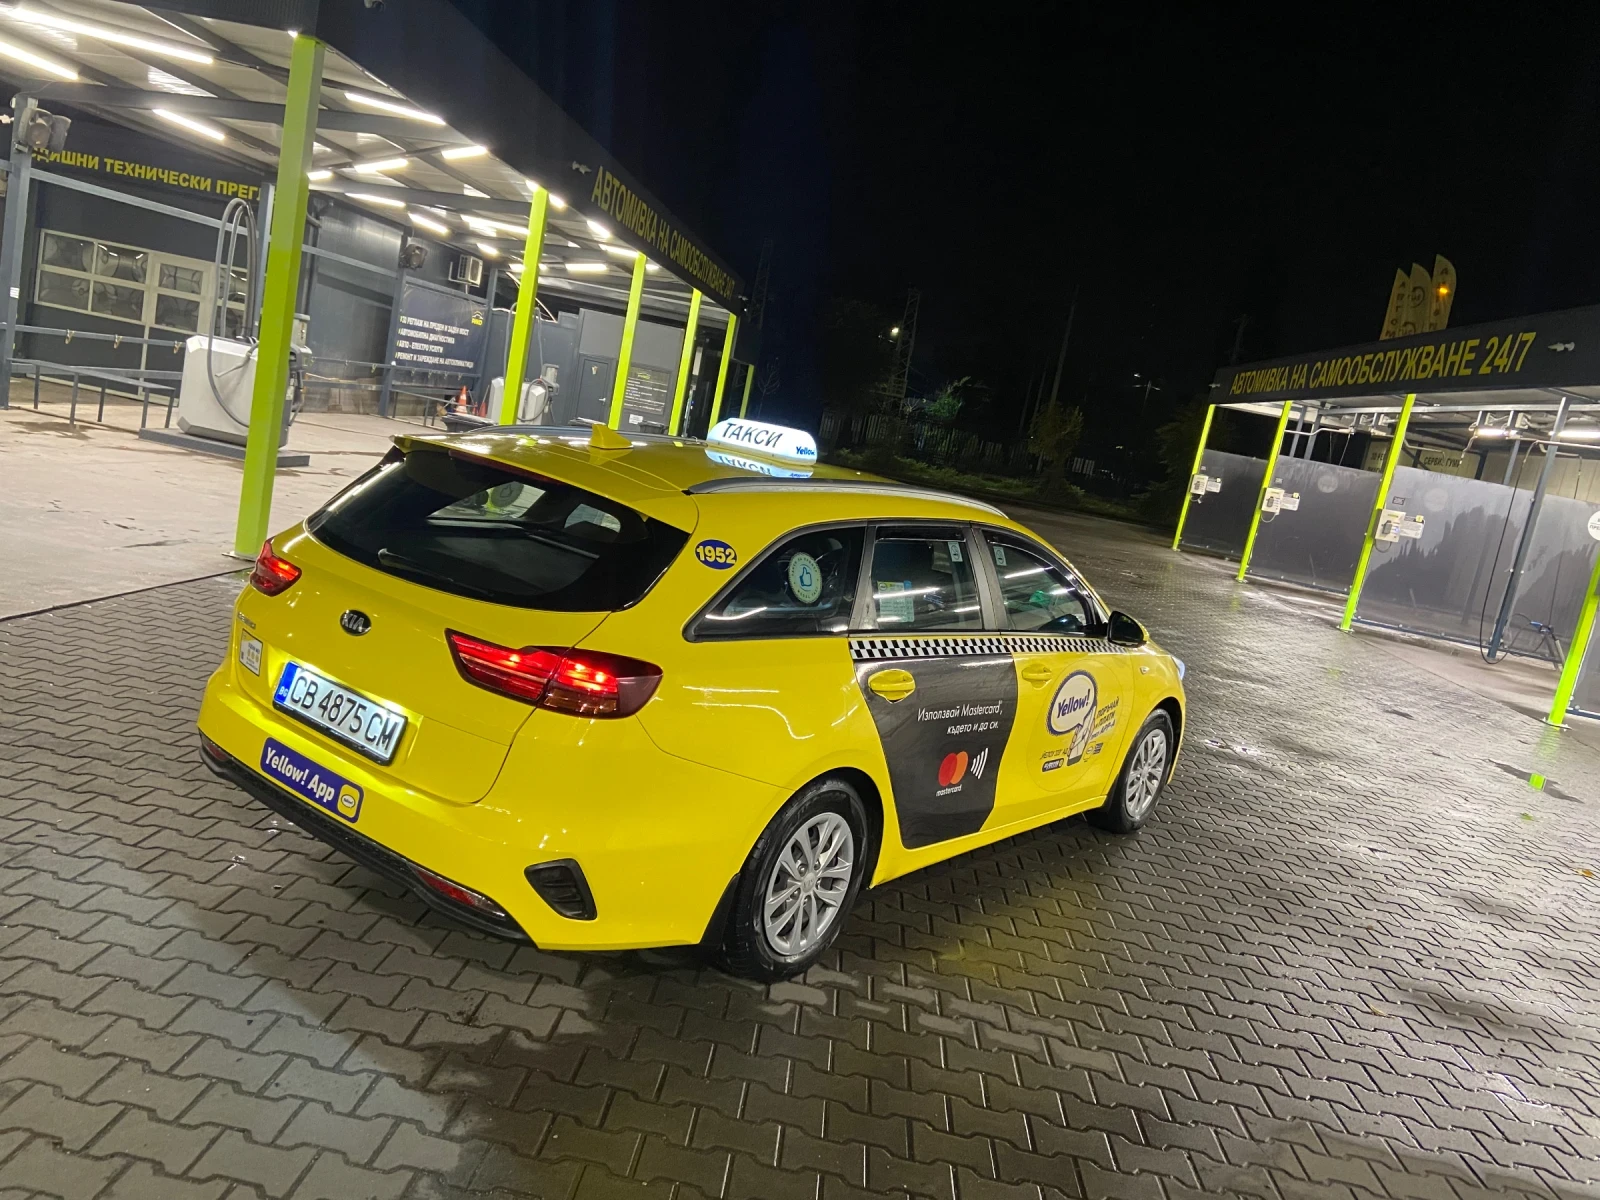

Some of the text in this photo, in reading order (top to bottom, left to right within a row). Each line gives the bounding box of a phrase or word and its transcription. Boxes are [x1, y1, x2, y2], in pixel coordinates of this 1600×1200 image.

[104, 158, 212, 192] ТЕХНИЧЕСКИ
[591, 165, 658, 245] АВТОМИВКА
[657, 219, 670, 256] НА
[1229, 331, 1537, 396] АВТОМИВКА НА САМООБСЛУЖВАНЕ 24/7
[722, 422, 784, 448] ТАКСИ
[696, 545, 736, 564] 1952
[342, 613, 365, 633] KIA
[278, 686, 289, 698] BG
[1057, 688, 1091, 719] Yellow!
[290, 676, 399, 751] CB 4875 CM
[917, 706, 960, 722] Използвай
[946, 724, 971, 735] където
[978, 722, 988, 732] да
[265, 747, 335, 803] Yellow! App
[936, 784, 962, 797] mastercard
